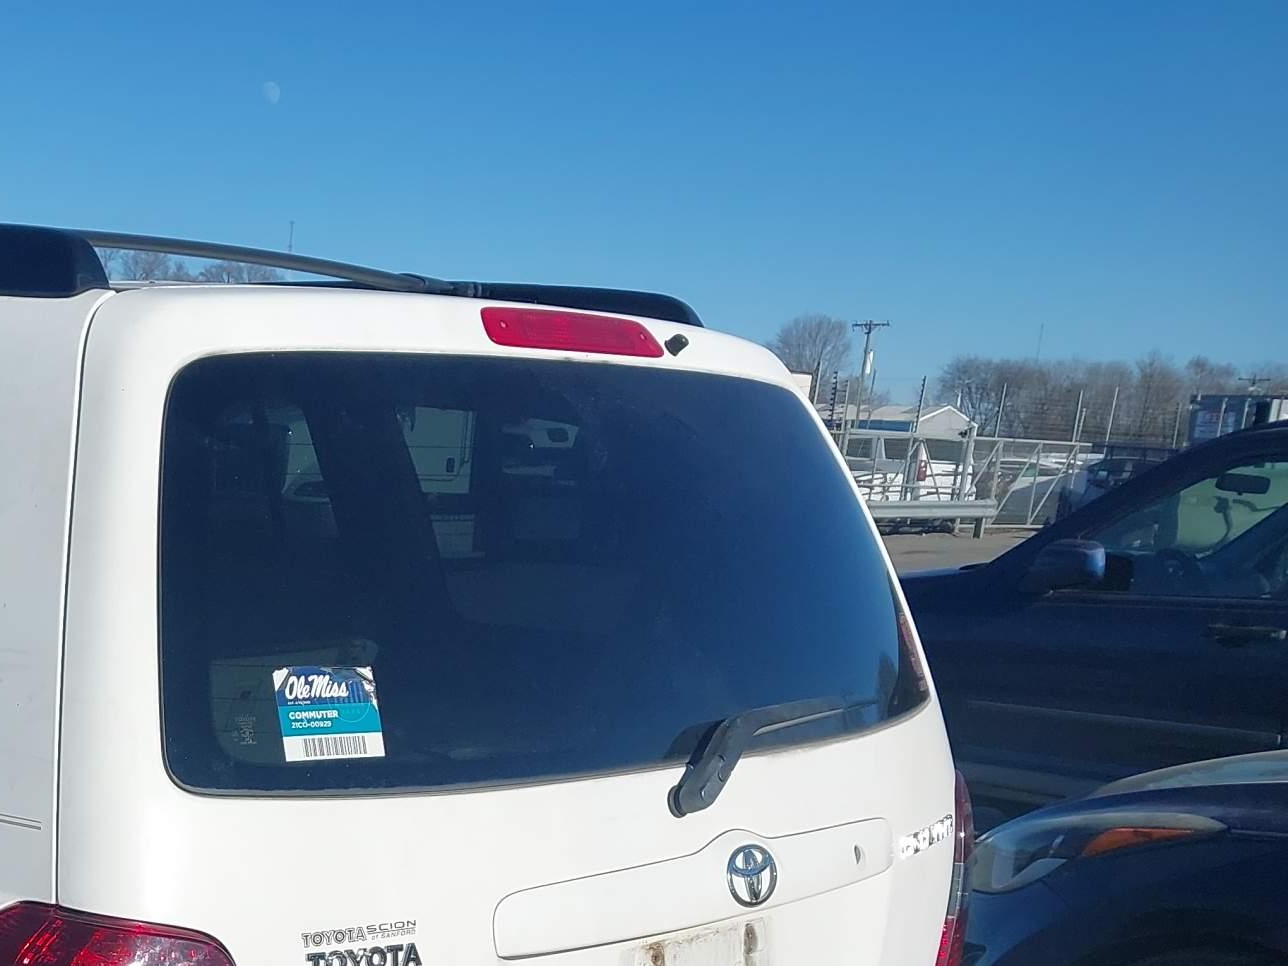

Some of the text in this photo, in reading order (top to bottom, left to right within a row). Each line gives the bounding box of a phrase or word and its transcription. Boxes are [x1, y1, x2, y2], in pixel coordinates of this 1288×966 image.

[285, 674, 349, 700] Ole Miss
[288, 709, 339, 720] COMMUTER
[301, 920, 417, 948] TOYOTA SCION
[380, 929, 416, 939] SANFORD
